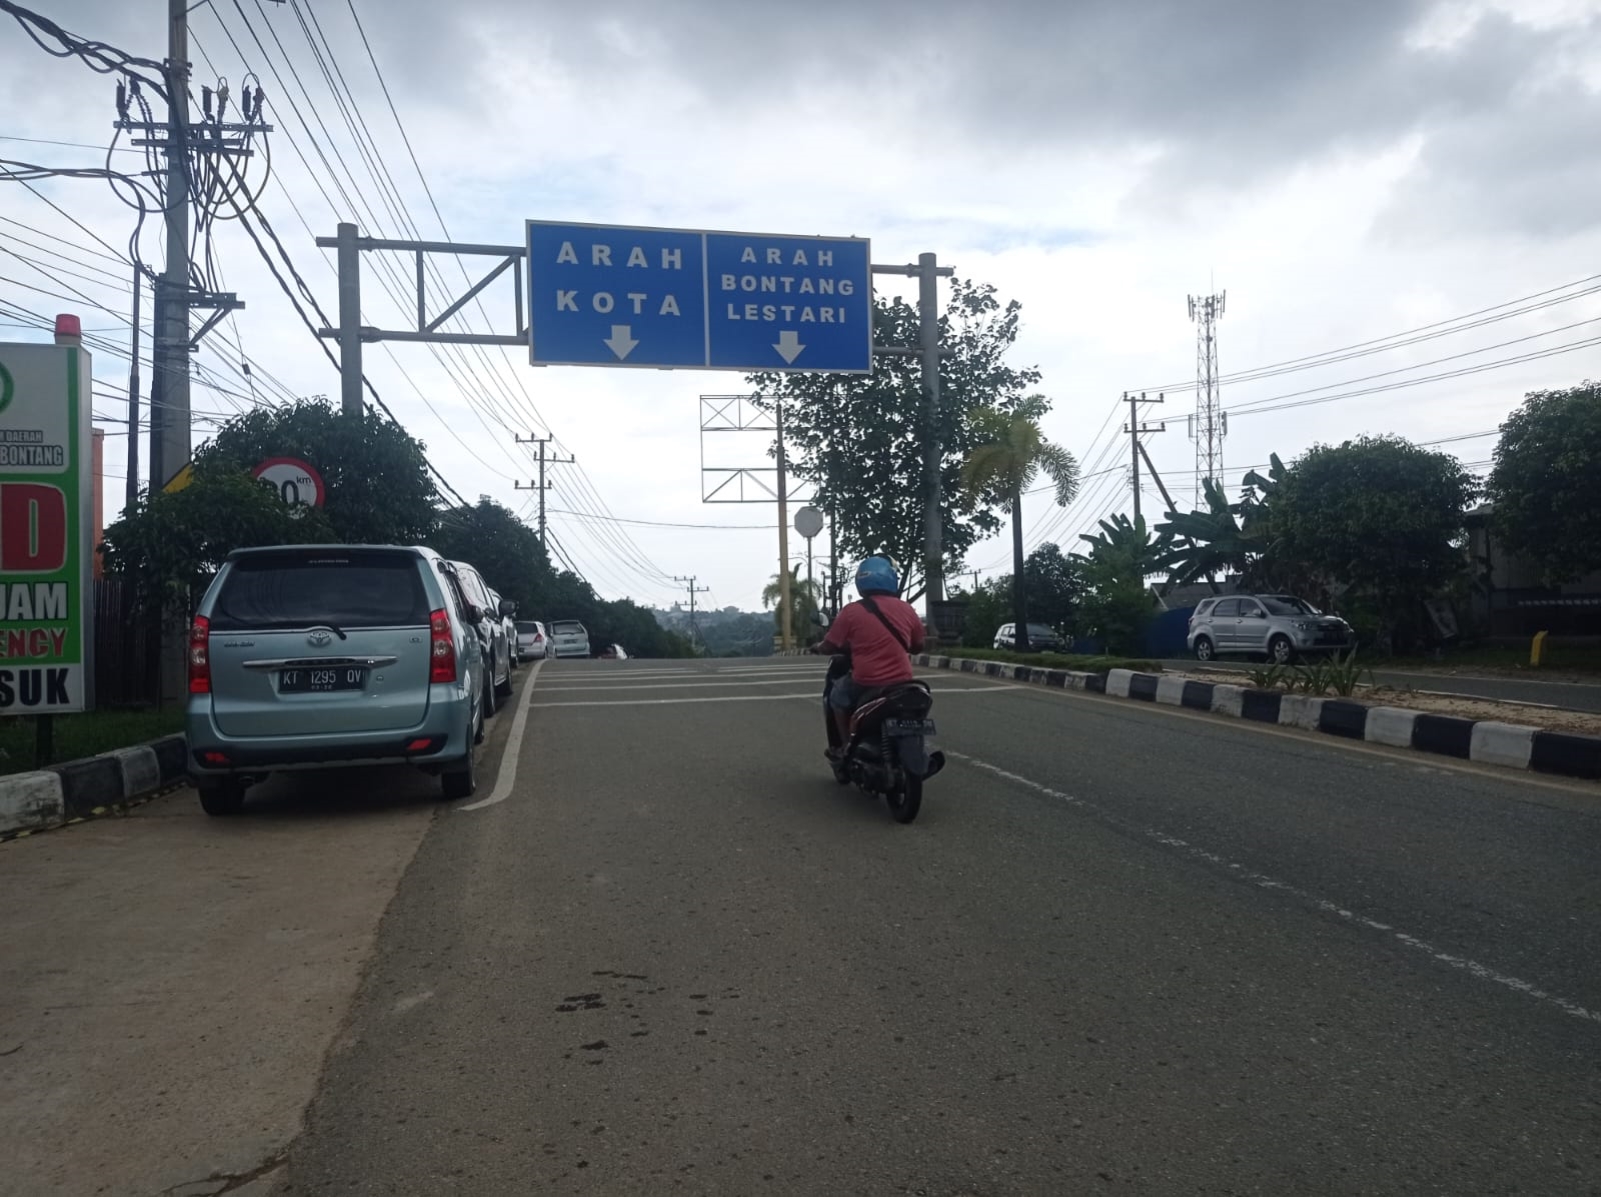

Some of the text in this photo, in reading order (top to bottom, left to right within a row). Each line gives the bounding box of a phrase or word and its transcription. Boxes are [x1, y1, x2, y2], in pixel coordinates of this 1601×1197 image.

[556, 241, 682, 270] ARAH
[741, 247, 833, 266] ARAH
[721, 274, 854, 295] BONTANG
[556, 289, 681, 316] KOTA
[727, 303, 846, 323] LESTARI
[6, 430, 43, 442] DAERAH
[0, 445, 63, 466] BONTANG
[296, 476, 312, 484] km
[283, 671, 298, 684] KT
[310, 670, 336, 684] 1295
[0, 668, 70, 708] SUK
